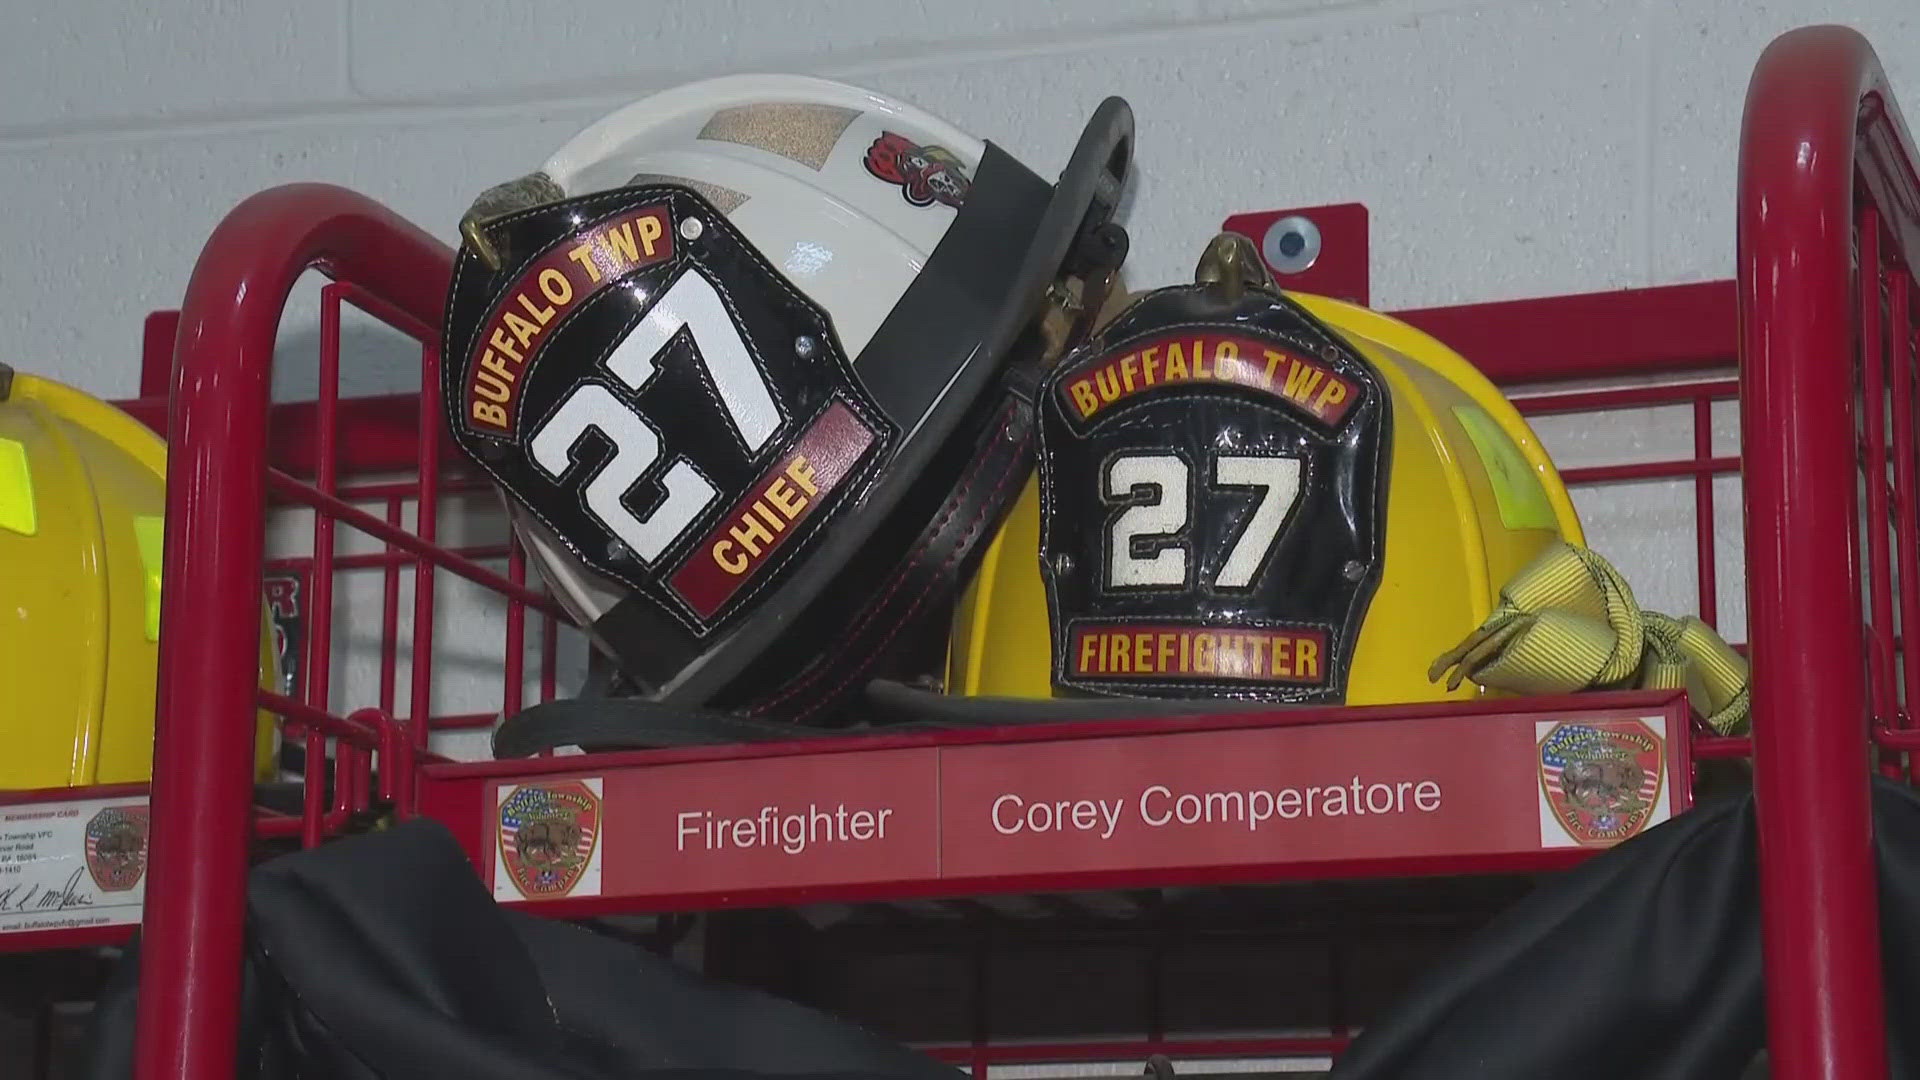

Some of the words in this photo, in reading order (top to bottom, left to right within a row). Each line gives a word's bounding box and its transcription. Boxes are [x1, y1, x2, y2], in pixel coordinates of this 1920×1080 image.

[474, 269, 573, 428] BUFFALO
[569, 216, 663, 284] TWP
[531, 267, 787, 565] 27
[1071, 341, 1239, 418] BUFFALO
[1253, 351, 1347, 414] TWP
[712, 456, 819, 575] CHIEF
[1110, 456, 1301, 587] 27
[1080, 633, 1318, 677] FIREFIGHTER
[1548, 731, 1594, 754] Buffalo
[1596, 729, 1655, 751] Township
[547, 792, 592, 811] Township
[677, 804, 893, 854] Firefighter
[992, 794, 1124, 839] Corey
[1140, 775, 1441, 830] Comperatore
[1588, 807, 1649, 838] Company
